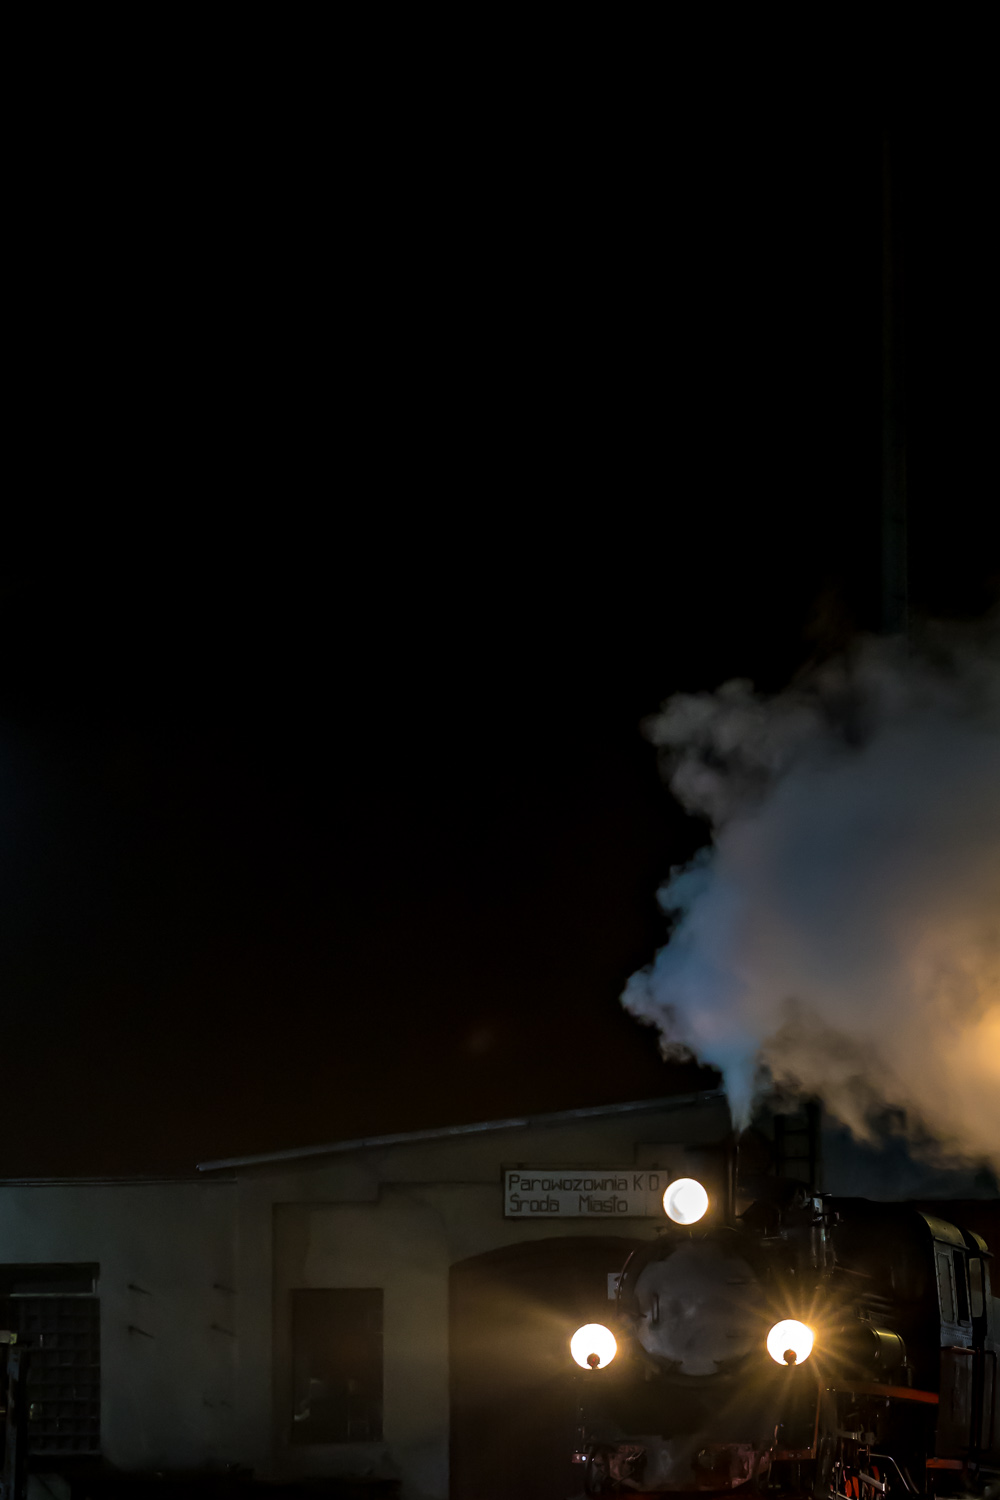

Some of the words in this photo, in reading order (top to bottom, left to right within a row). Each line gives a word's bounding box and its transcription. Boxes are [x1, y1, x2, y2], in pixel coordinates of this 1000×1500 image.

[509, 1174, 627, 1191] Parowozownia
[510, 1194, 559, 1212] Środa
[578, 1194, 629, 1212] Miasto
